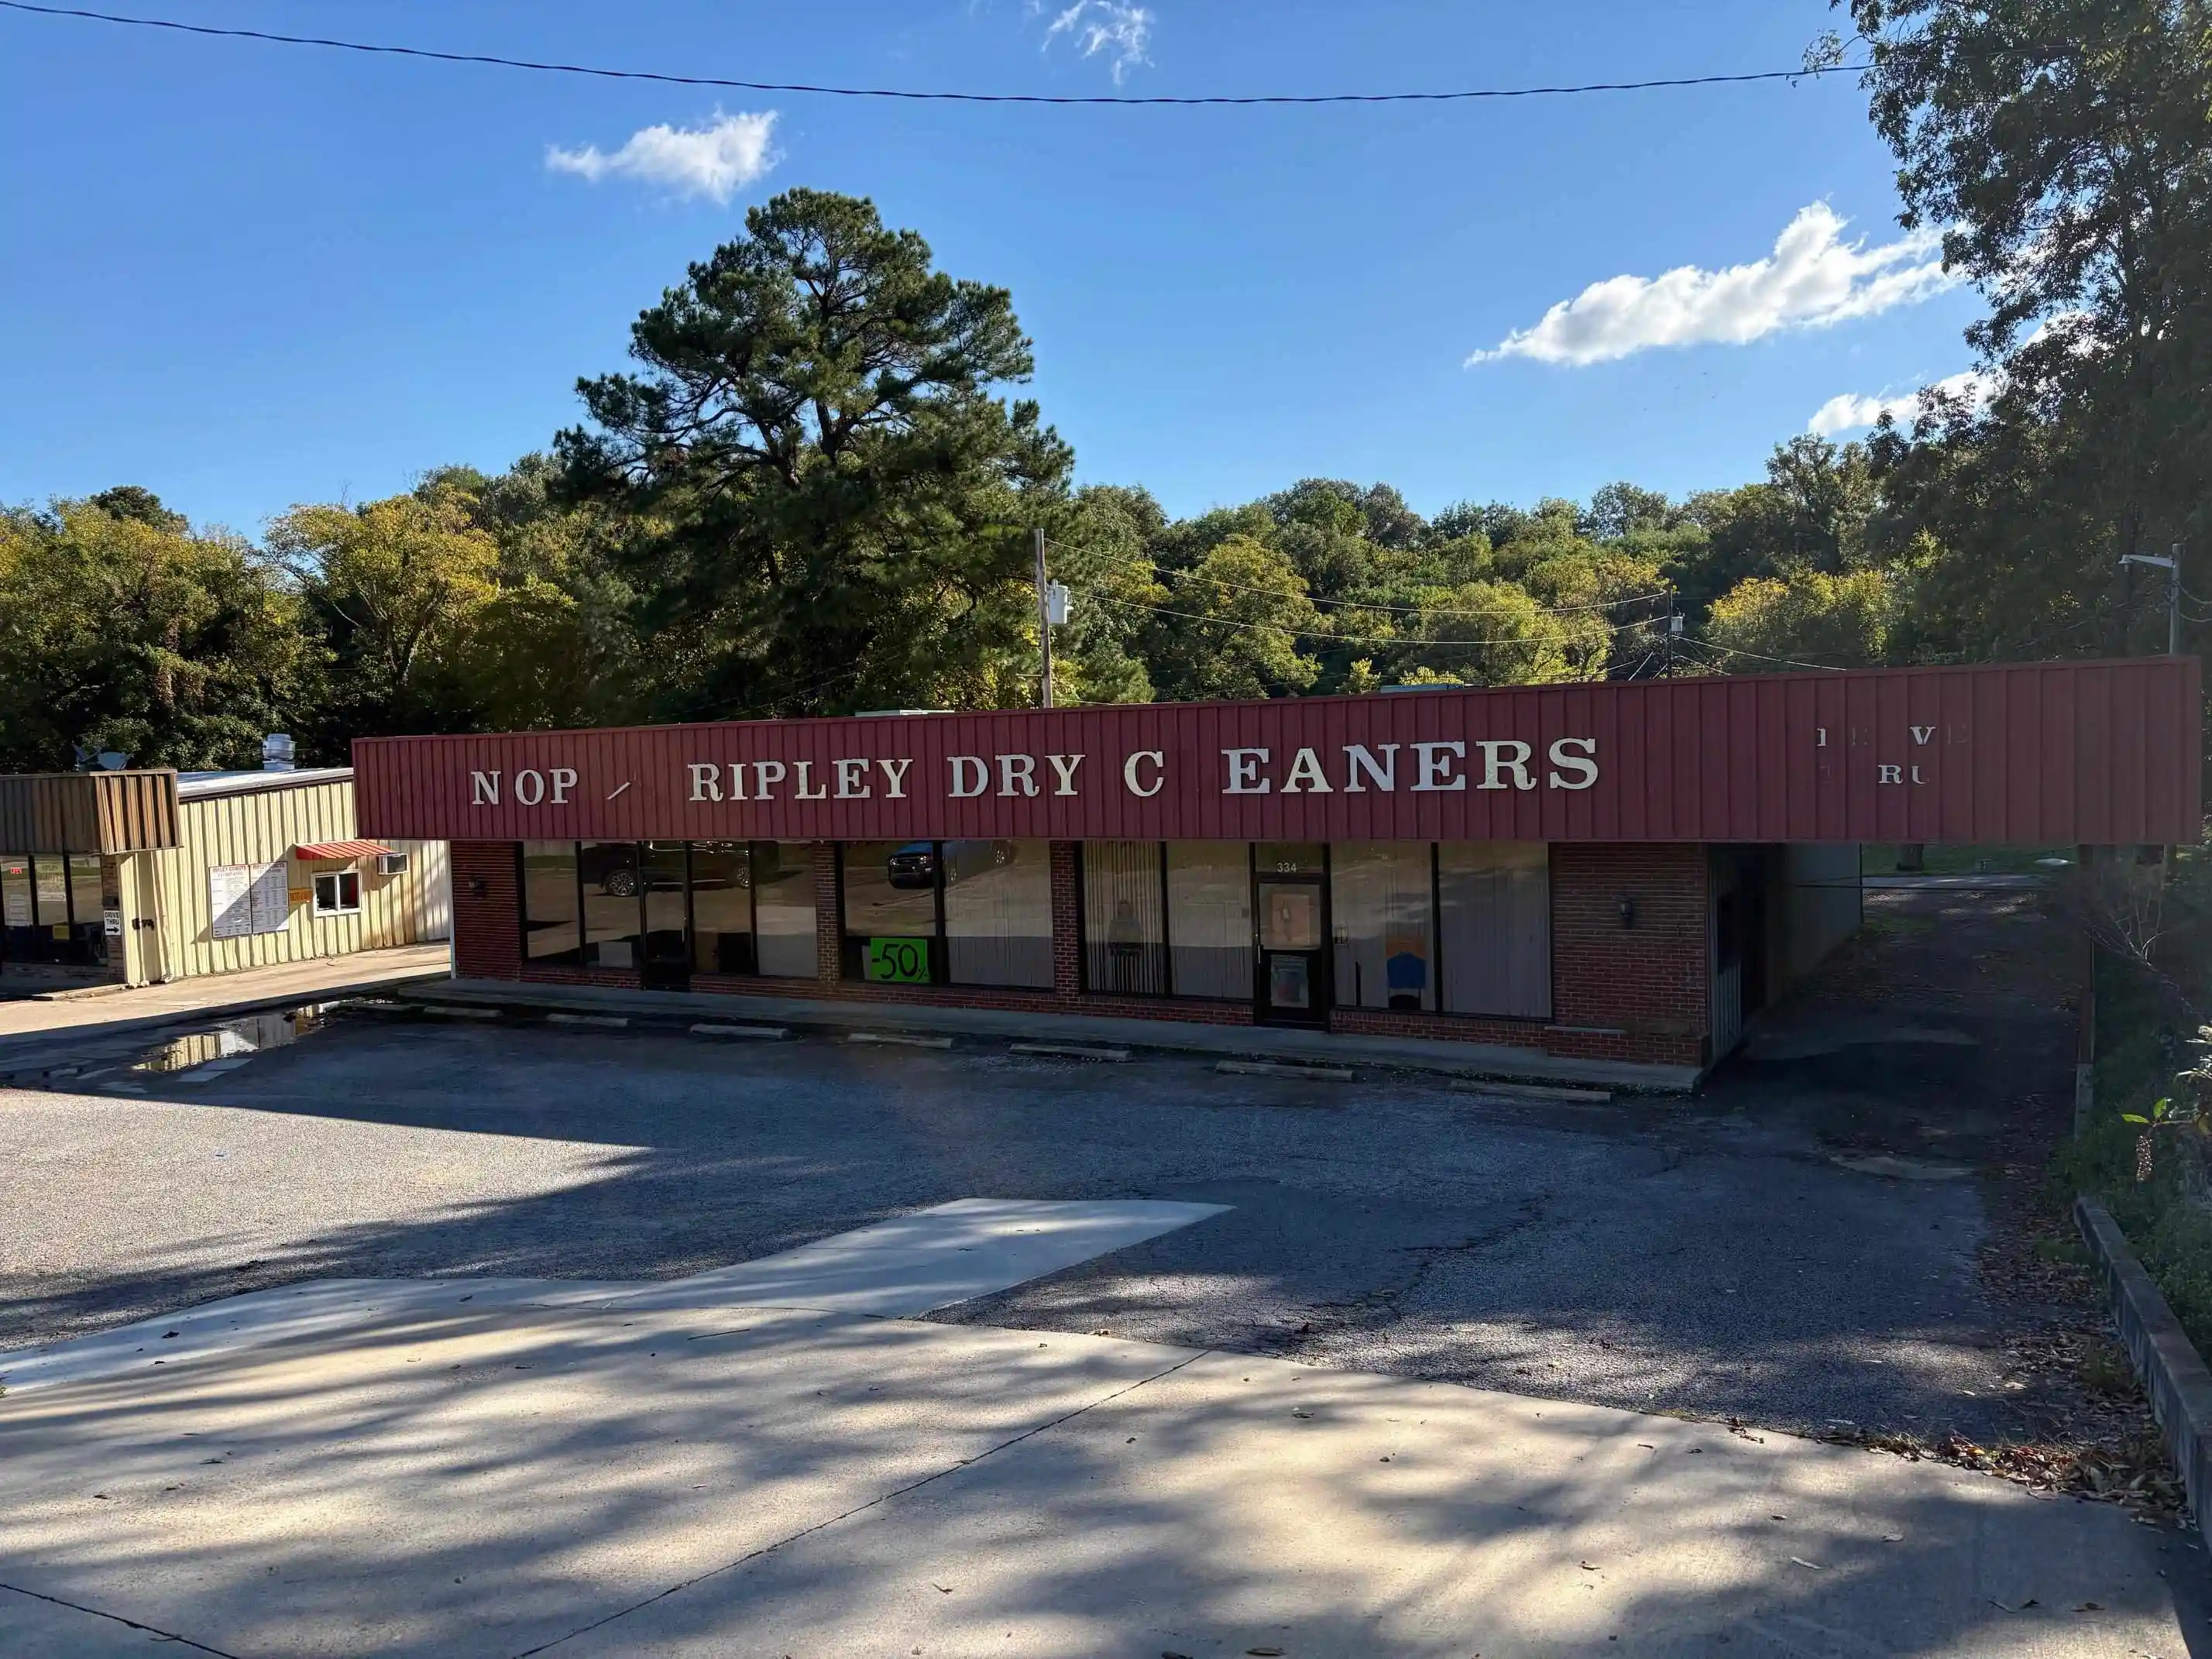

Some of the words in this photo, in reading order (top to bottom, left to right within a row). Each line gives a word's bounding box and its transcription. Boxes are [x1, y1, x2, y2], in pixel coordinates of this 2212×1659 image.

[471, 768, 579, 806] NOP
[687, 757, 914, 802] RIPLEY
[946, 753, 1086, 799] DRY
[1277, 862, 1297, 873] 334
